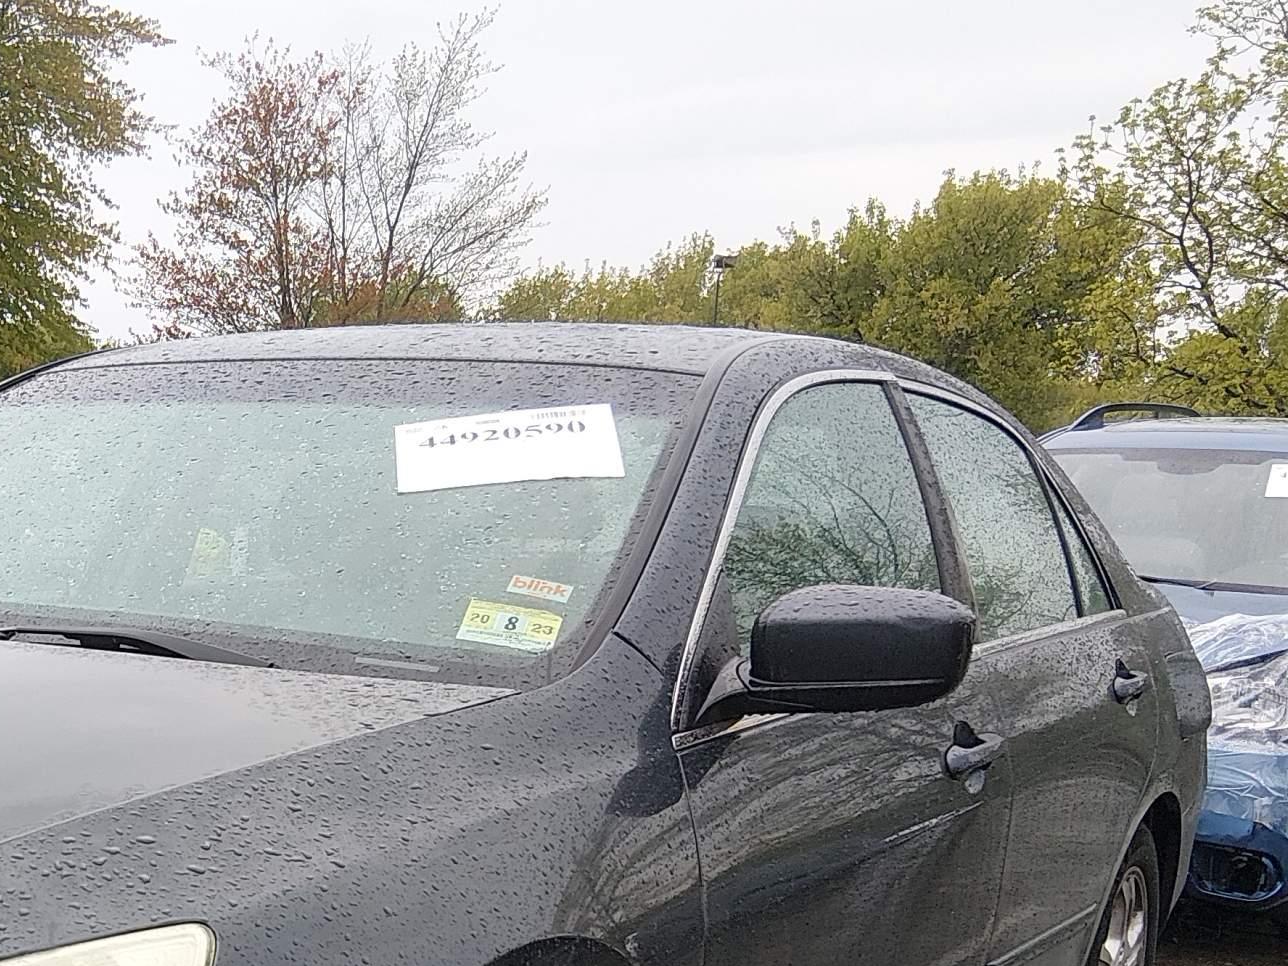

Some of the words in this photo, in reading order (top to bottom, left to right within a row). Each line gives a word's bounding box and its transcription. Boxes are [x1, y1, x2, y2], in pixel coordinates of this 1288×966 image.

[418, 420, 586, 448] 44920590
[512, 577, 568, 597] blink
[470, 613, 490, 625] 20
[504, 616, 519, 631] 8
[531, 623, 554, 636] 23
